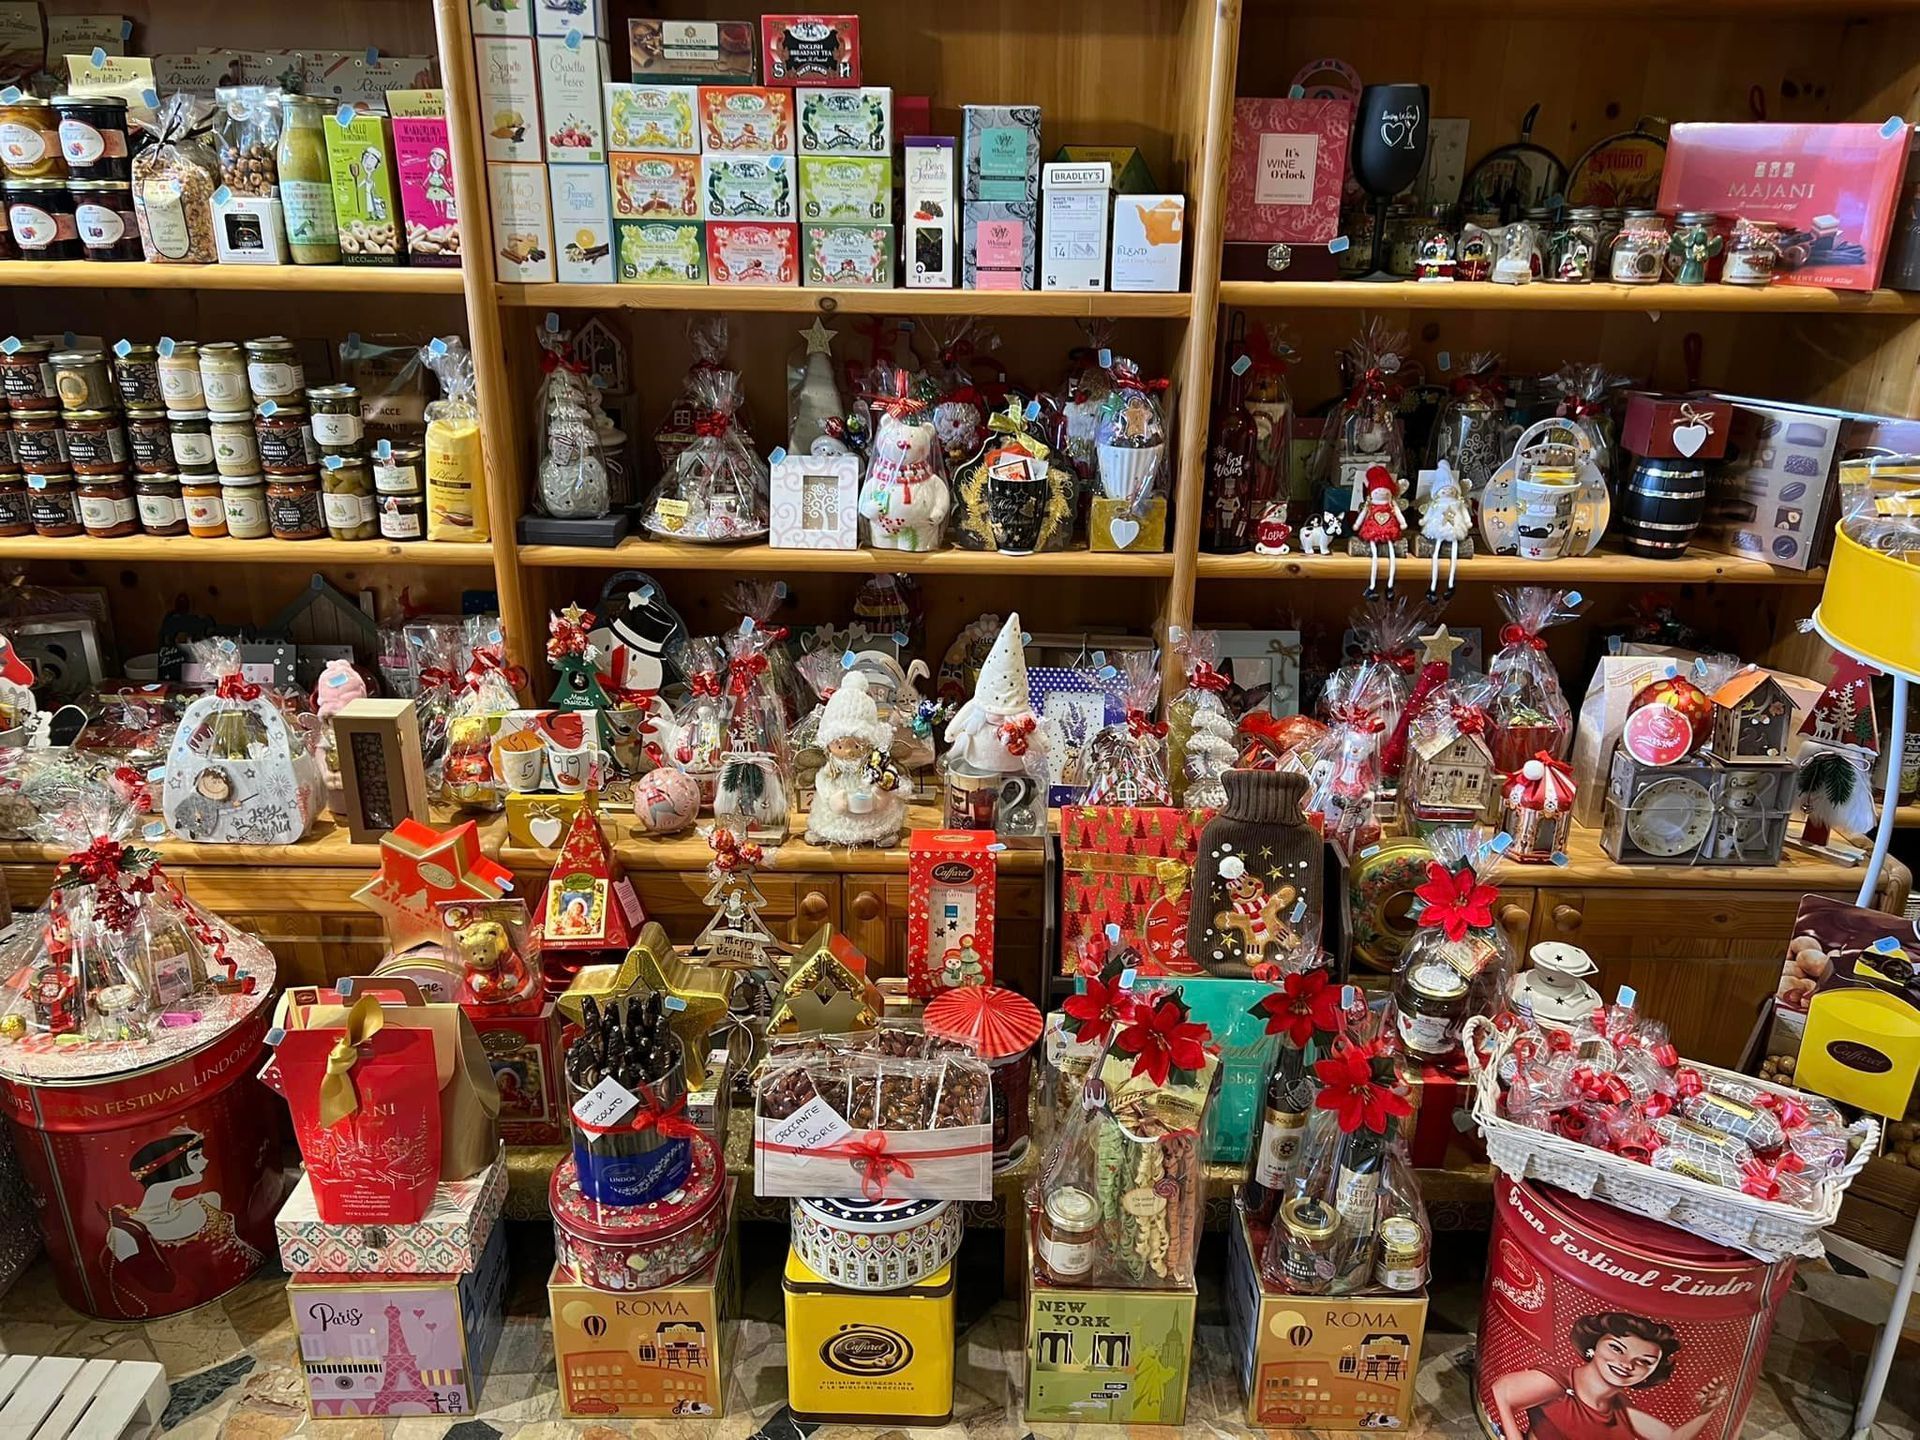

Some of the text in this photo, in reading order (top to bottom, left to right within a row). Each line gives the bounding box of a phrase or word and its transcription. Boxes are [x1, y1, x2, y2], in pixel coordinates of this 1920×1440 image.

[773, 63, 785, 78] S
[839, 63, 851, 78] H
[353, 77, 403, 92] Risotto
[1285, 147, 1299, 158] It's
[1267, 159, 1296, 169] WINE
[1054, 171, 1101, 181] BRADLEY'S
[1270, 169, 1306, 180] O'clock
[1727, 182, 1815, 199] MAJANI
[1054, 247, 1066, 258] 14
[361, 404, 401, 417] FOACCE
[1262, 528, 1286, 541] Love
[935, 864, 972, 879] Caffarel
[1833, 1044, 1886, 1067] Caffarel
[105, 1083, 187, 1115] FESTIVAL
[193, 1046, 248, 1088] LINDOR
[774, 1104, 821, 1144] CROCCANTE
[797, 1128, 810, 1139] DI
[1507, 1186, 1756, 1297] Gran Festival Lindor
[615, 1300, 689, 1316] ROMA
[1037, 1300, 1087, 1314] NEW
[309, 1302, 364, 1333] Paris
[1052, 1314, 1111, 1328] YORK
[1325, 1311, 1399, 1329] ROMA
[844, 1340, 886, 1354] Caffarel
